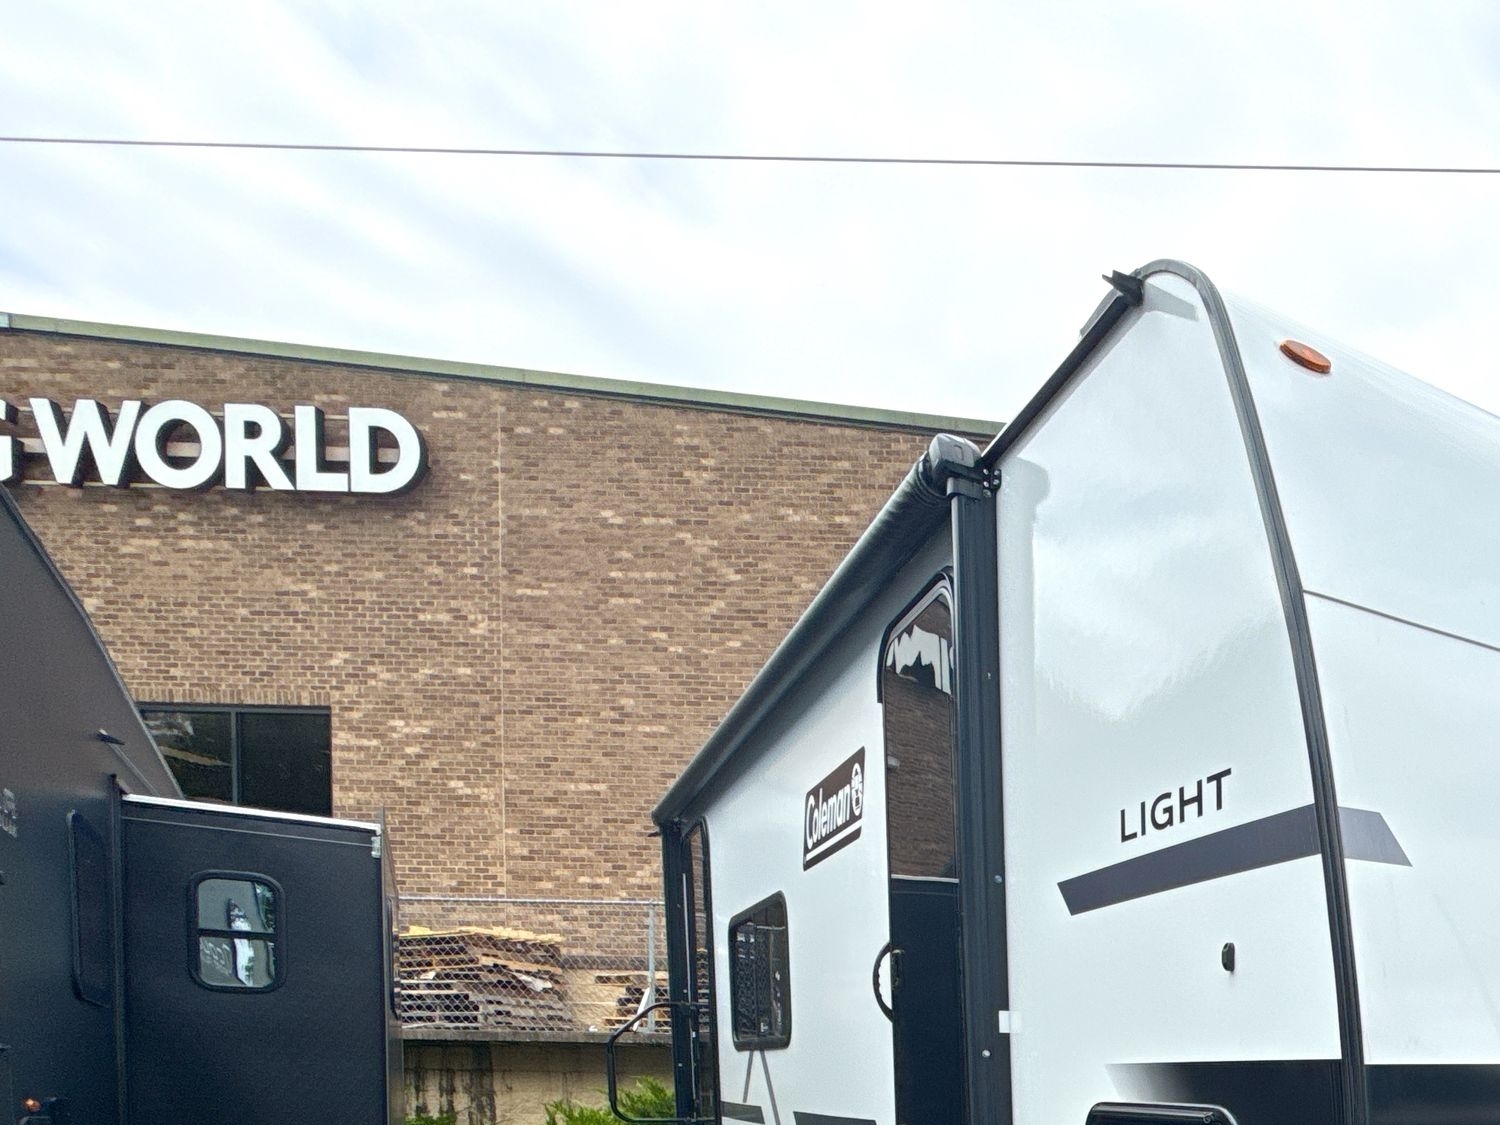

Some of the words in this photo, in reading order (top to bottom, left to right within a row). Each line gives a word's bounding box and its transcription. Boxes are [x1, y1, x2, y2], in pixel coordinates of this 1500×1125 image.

[30, 398, 422, 494] WORLD
[807, 783, 851, 850] Coleman
[1120, 767, 1232, 843] LIGHT
